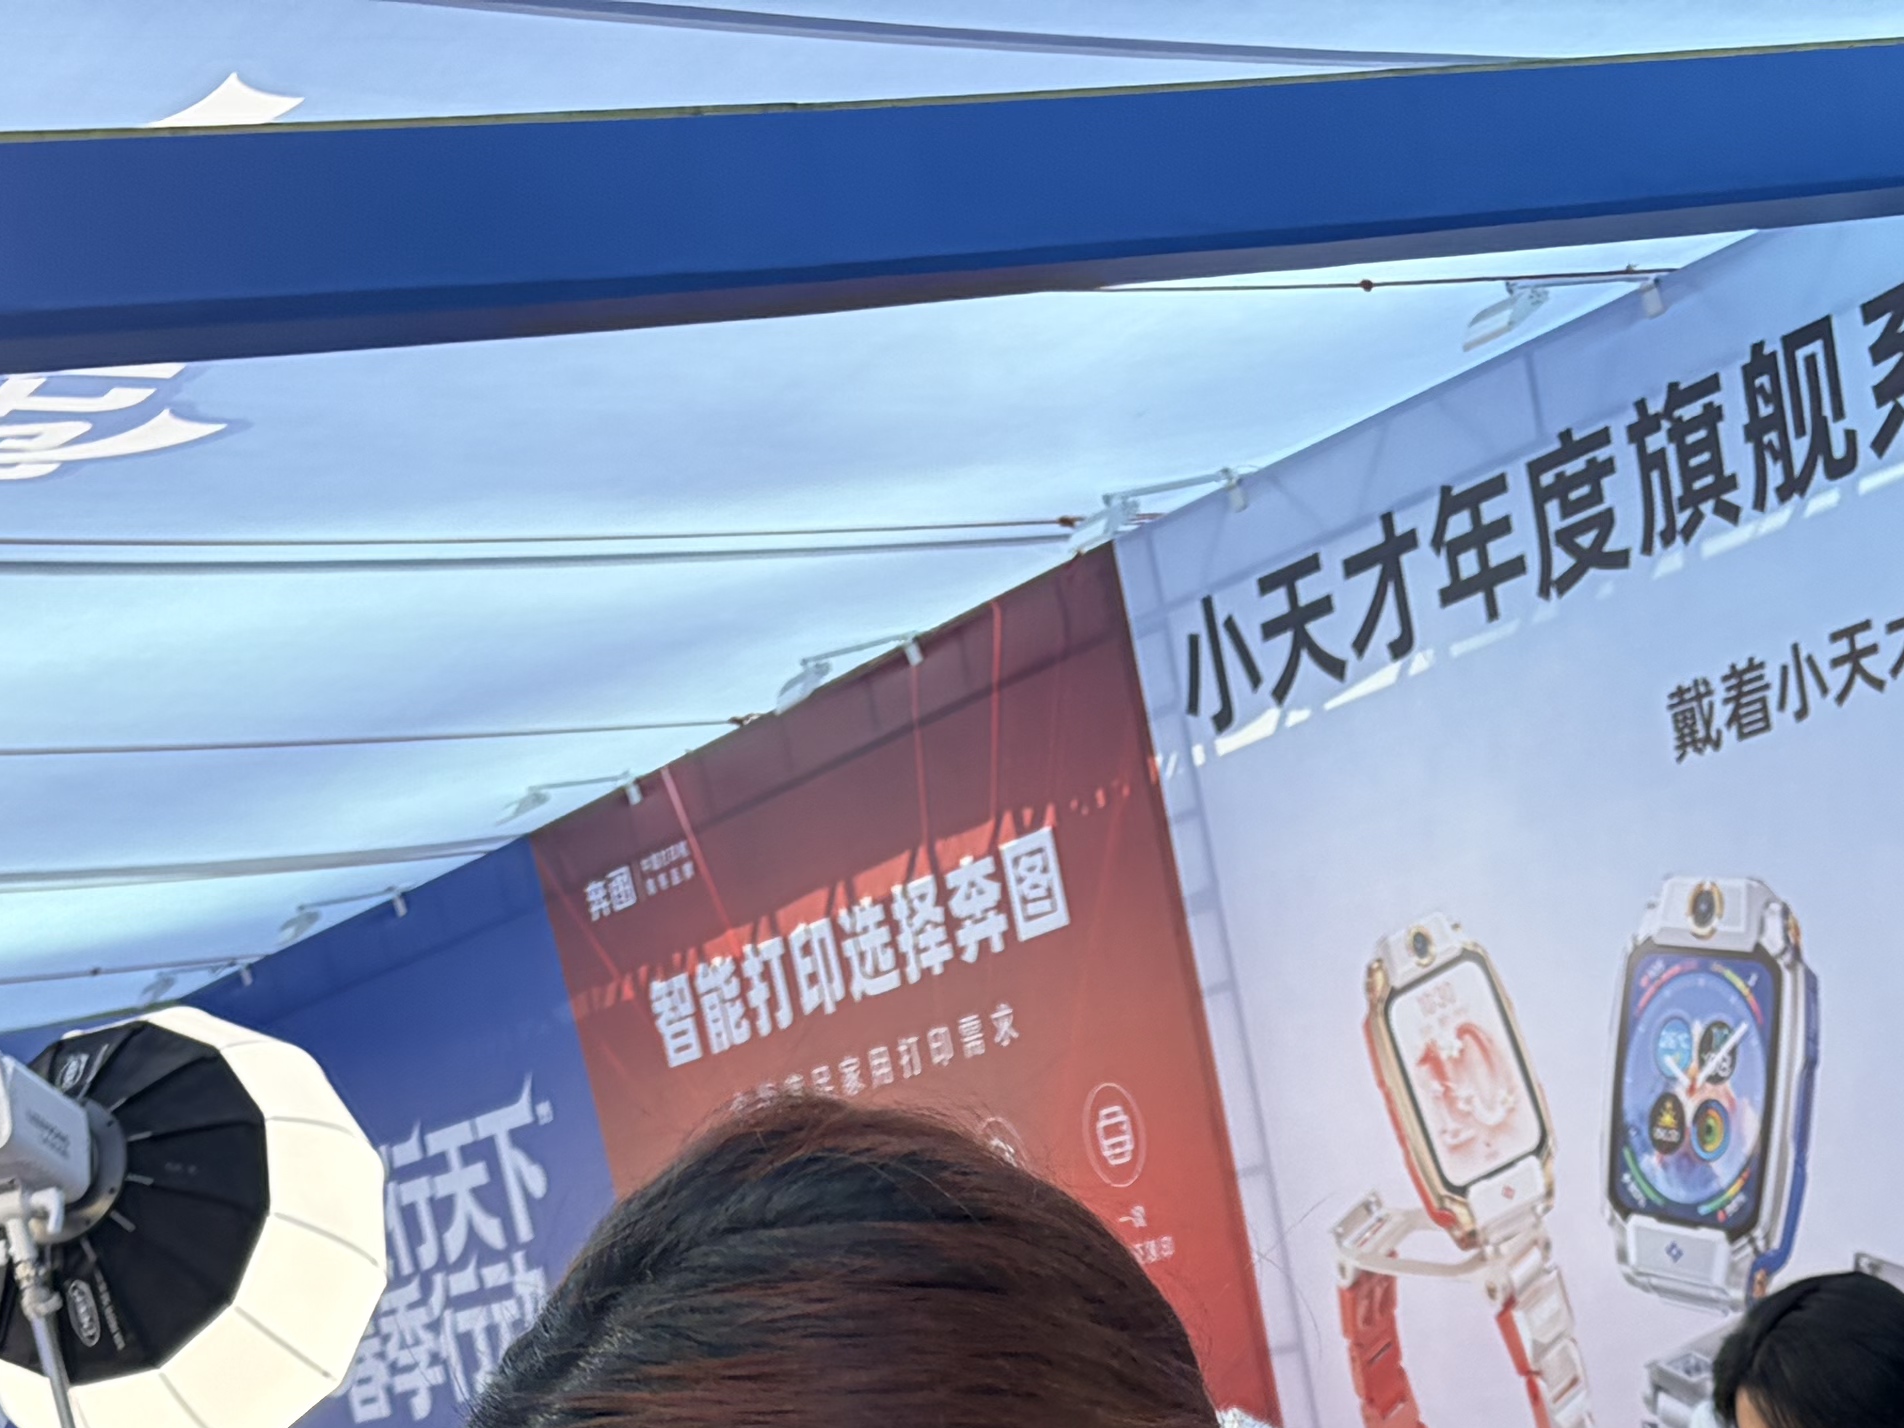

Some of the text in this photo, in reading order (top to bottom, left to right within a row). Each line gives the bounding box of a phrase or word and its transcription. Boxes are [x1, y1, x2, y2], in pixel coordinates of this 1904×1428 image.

[648, 825, 1071, 1068] 智能打印选择奔图
